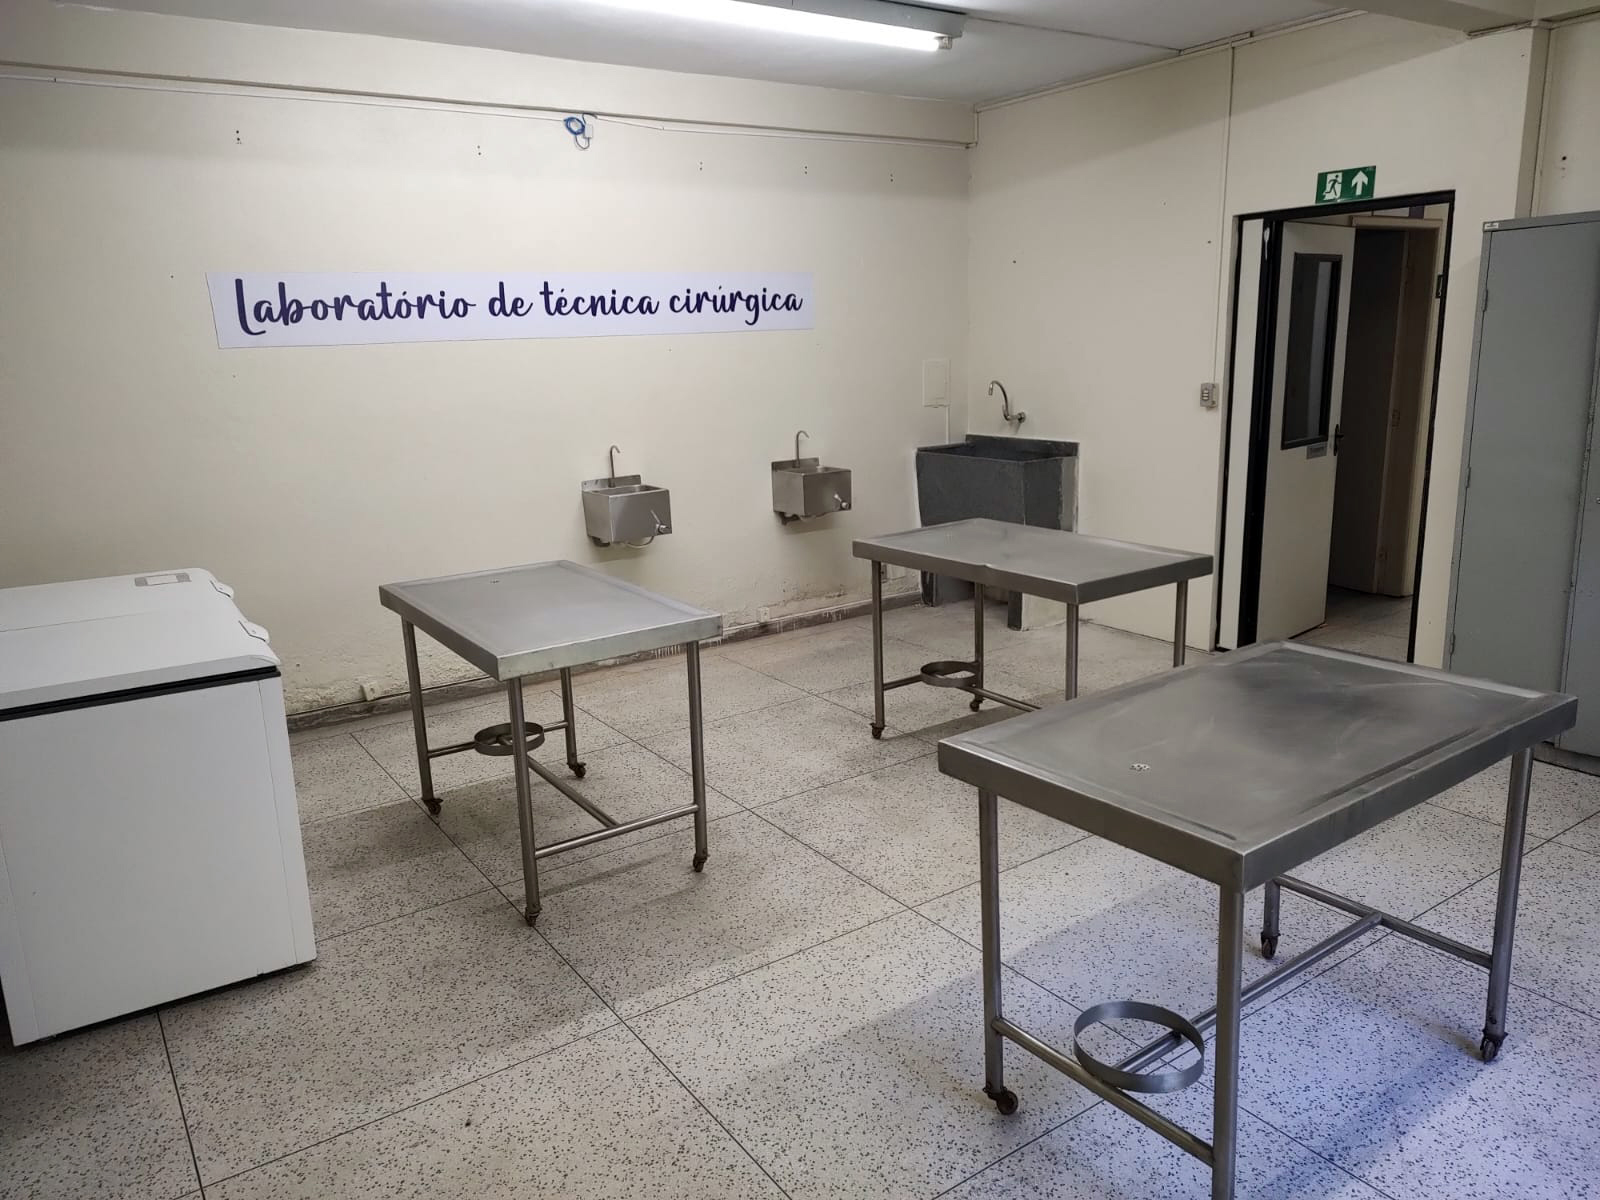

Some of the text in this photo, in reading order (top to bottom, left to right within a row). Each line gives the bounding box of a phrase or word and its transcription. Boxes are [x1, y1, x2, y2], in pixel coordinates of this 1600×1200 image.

[235, 278, 804, 336] Laboratório de técnica cirúrgica
